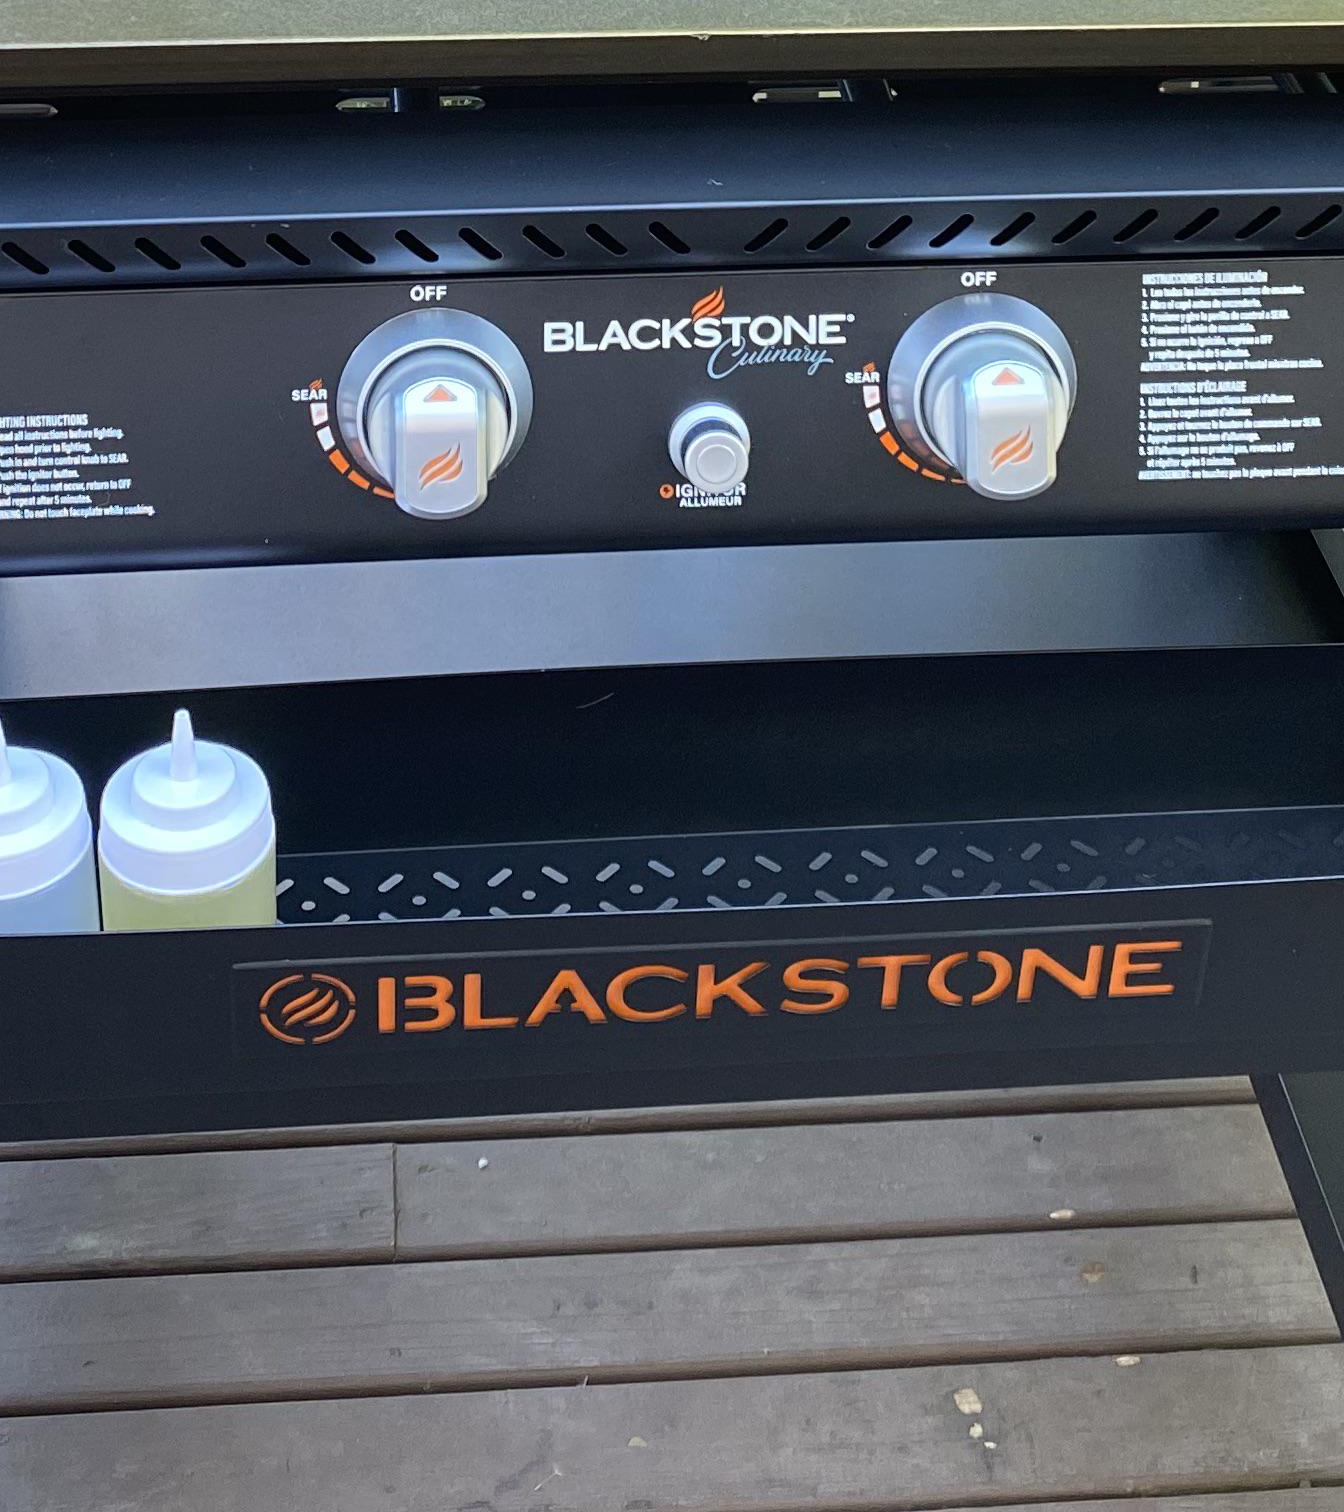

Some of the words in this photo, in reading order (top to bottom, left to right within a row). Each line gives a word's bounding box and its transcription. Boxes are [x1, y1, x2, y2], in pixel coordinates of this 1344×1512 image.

[960, 270, 998, 287] OFF
[409, 284, 447, 302] OFF
[706, 336, 834, 380] Culinary
[844, 372, 880, 384] SEAR
[291, 388, 328, 402] SEAR
[26, 414, 88, 427] INSTRUCTIONS
[679, 495, 742, 507] ALLUMEUR
[375, 940, 1184, 1034] BLACKSTONE
